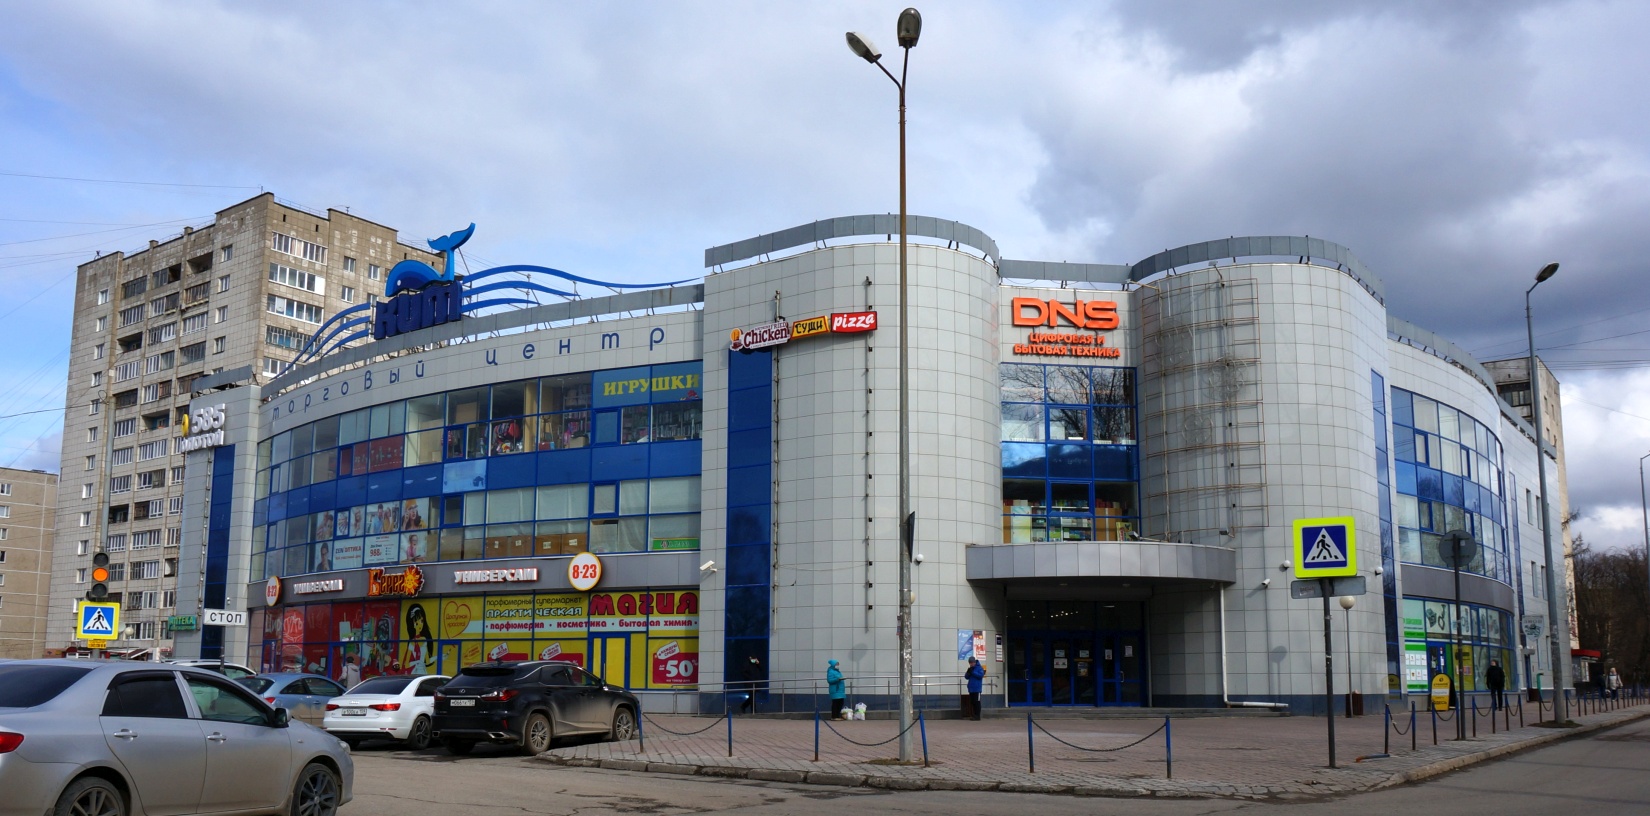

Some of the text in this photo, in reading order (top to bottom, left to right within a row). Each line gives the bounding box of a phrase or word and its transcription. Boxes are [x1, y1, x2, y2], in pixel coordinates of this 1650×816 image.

[1013, 297, 1120, 329] DNS
[832, 313, 875, 331] pizza
[743, 326, 788, 347] Chicken
[1029, 332, 1106, 345] ЦИФРОВАЯ И
[1013, 344, 1121, 358] БЫТОВАЯ ТЕХНИКА
[273, 327, 666, 420] торговый центр
[604, 374, 699, 396] ИГРУШКИ
[191, 403, 225, 433] 585
[454, 567, 538, 583] УНИВЕРСАМ
[572, 563, 597, 579] 8-23
[536, 596, 582, 606] супермаркет
[209, 612, 242, 624] СТОП
[664, 619, 692, 627] химия
